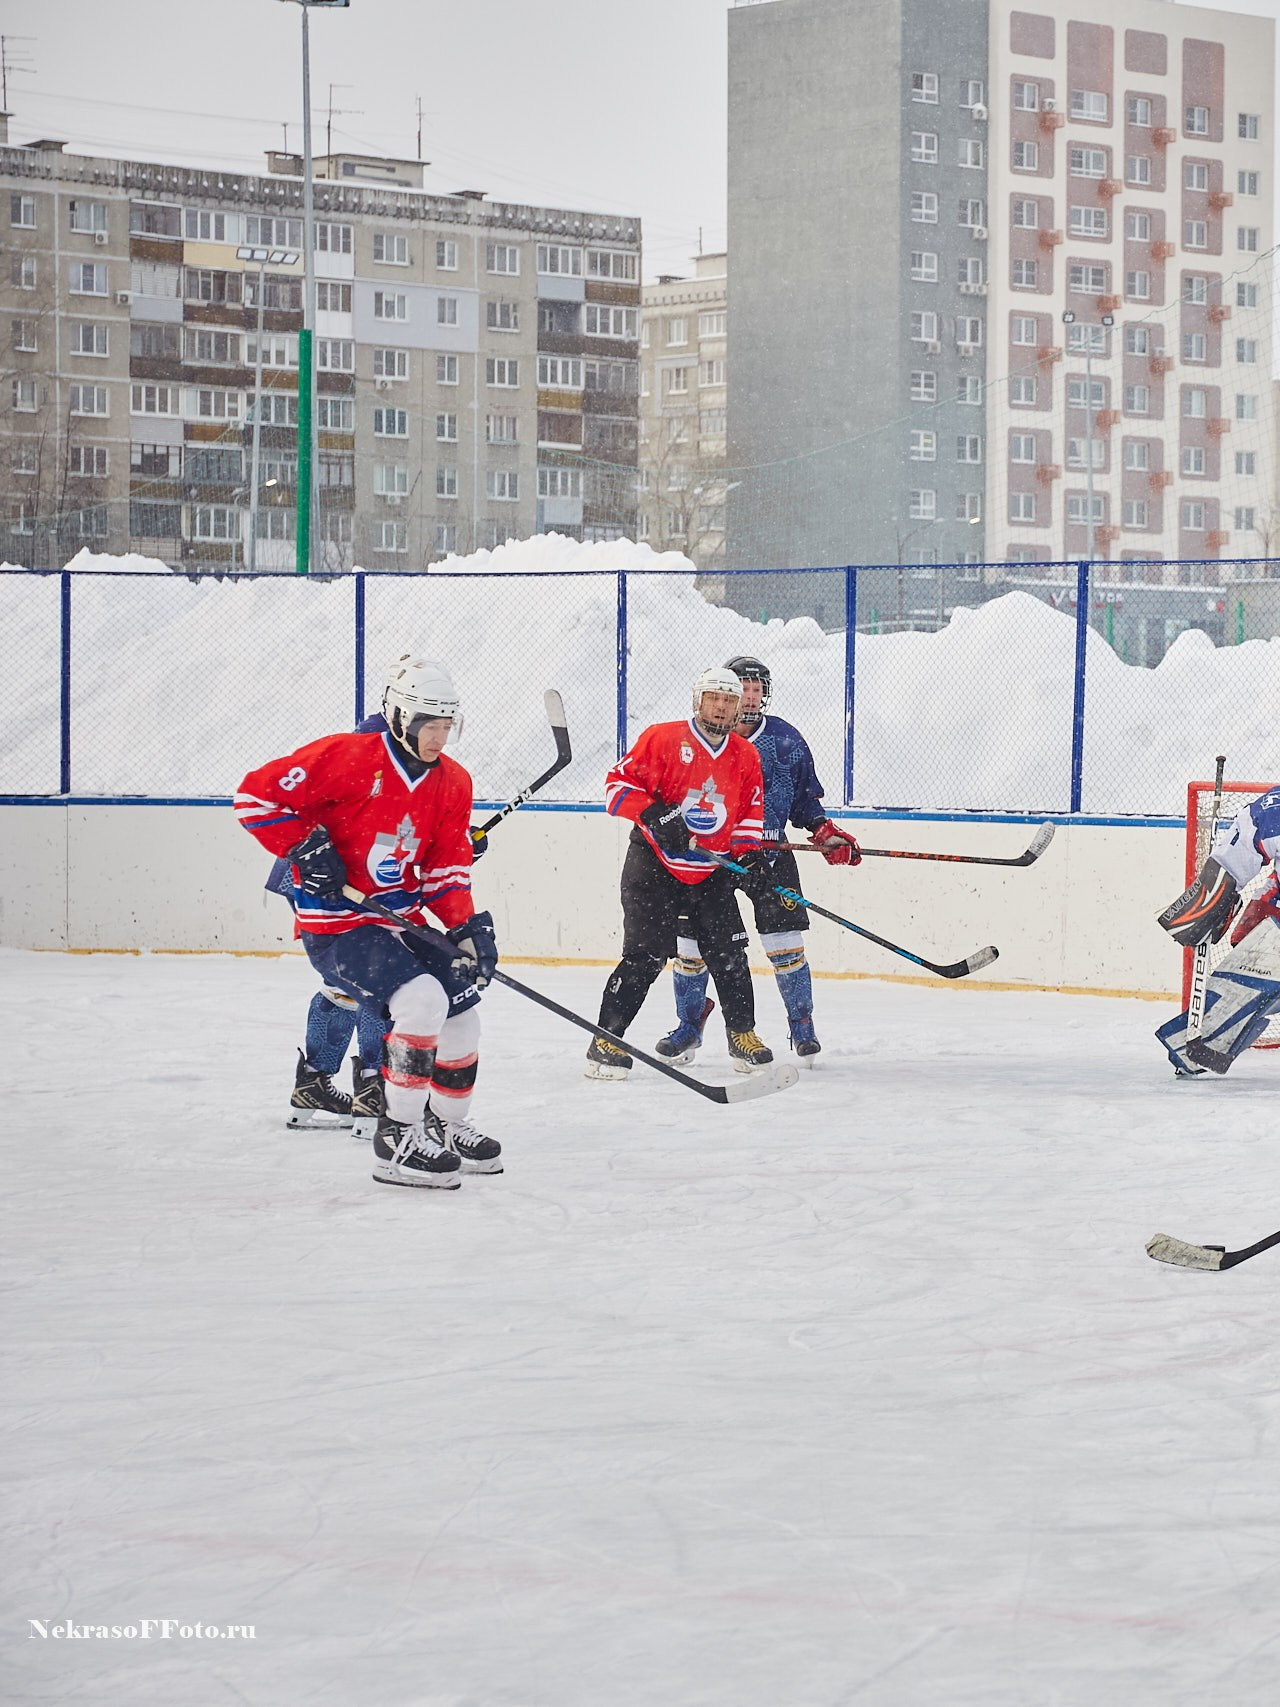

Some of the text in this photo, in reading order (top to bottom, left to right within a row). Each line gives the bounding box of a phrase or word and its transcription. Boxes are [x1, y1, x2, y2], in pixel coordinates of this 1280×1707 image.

[278, 765, 307, 792] 8
[499, 787, 534, 819] CCM
[658, 806, 682, 826] Reebo
[1162, 877, 1202, 921] VAUGHN
